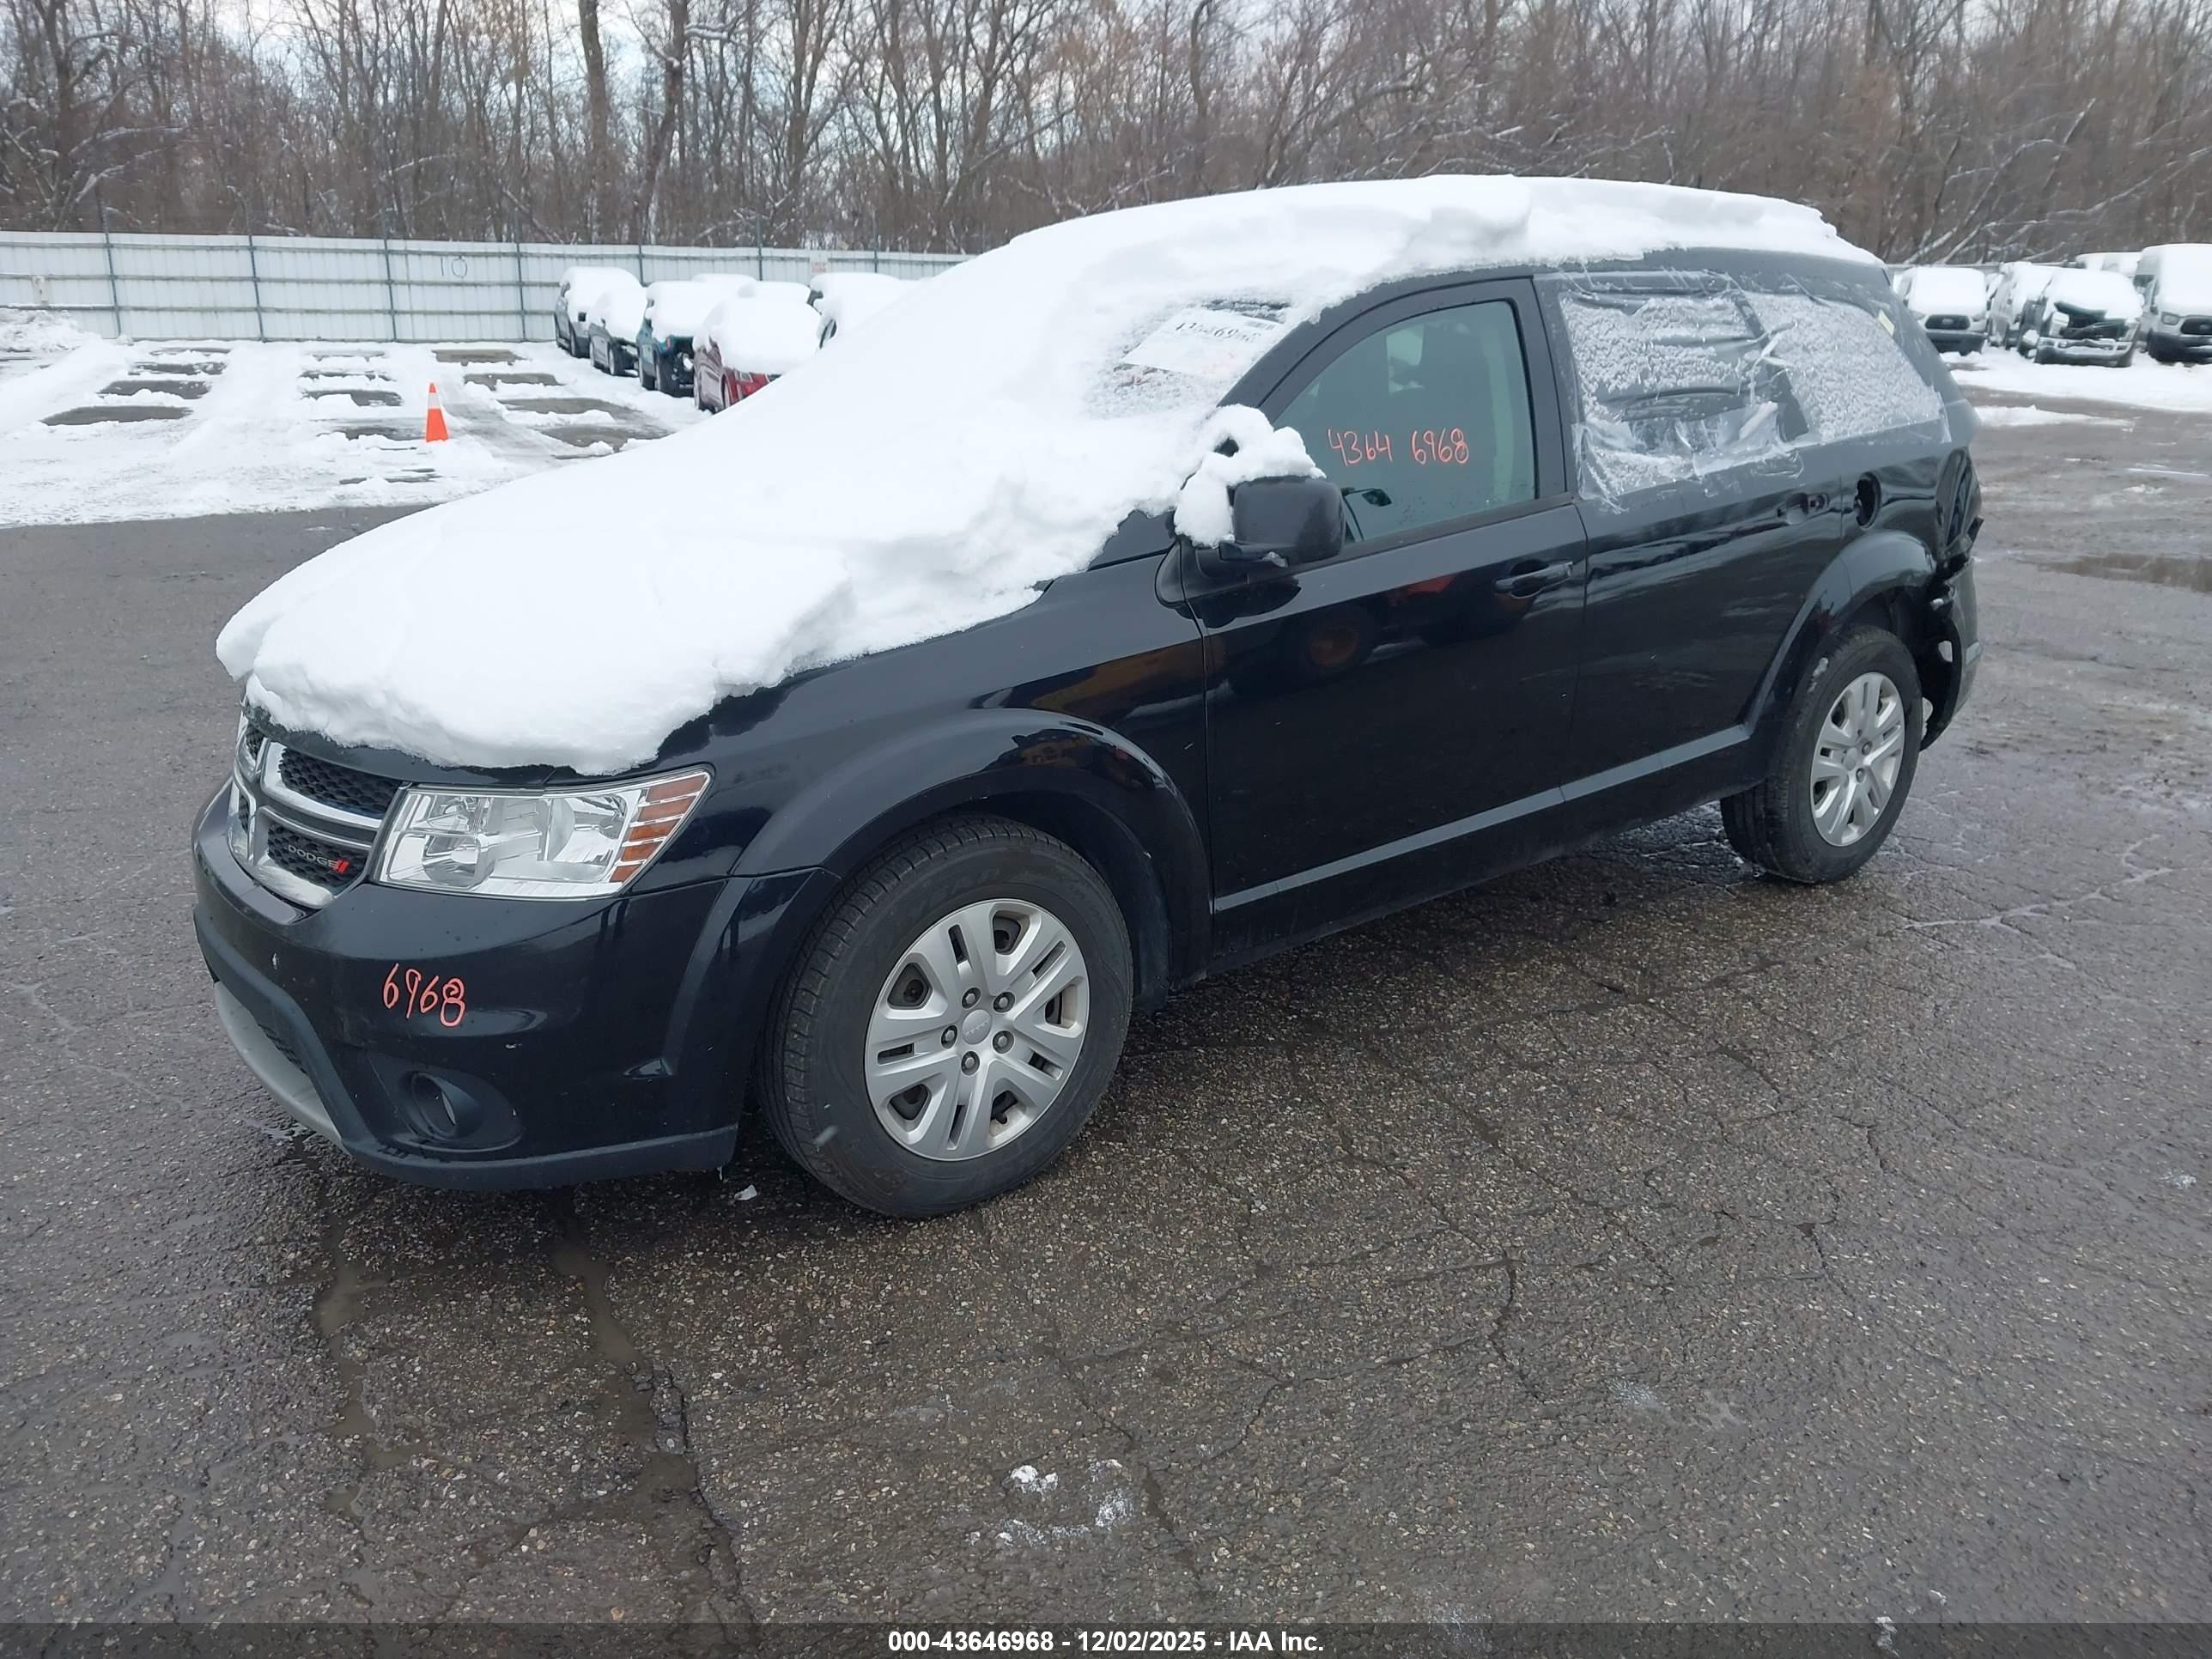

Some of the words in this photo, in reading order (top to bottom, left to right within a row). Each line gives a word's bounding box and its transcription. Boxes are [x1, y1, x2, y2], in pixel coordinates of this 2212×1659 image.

[1328, 428, 1392, 466] 4364
[1412, 428, 1469, 465] 6968
[288, 844, 339, 871] DODGE
[383, 963, 465, 1027] 6968
